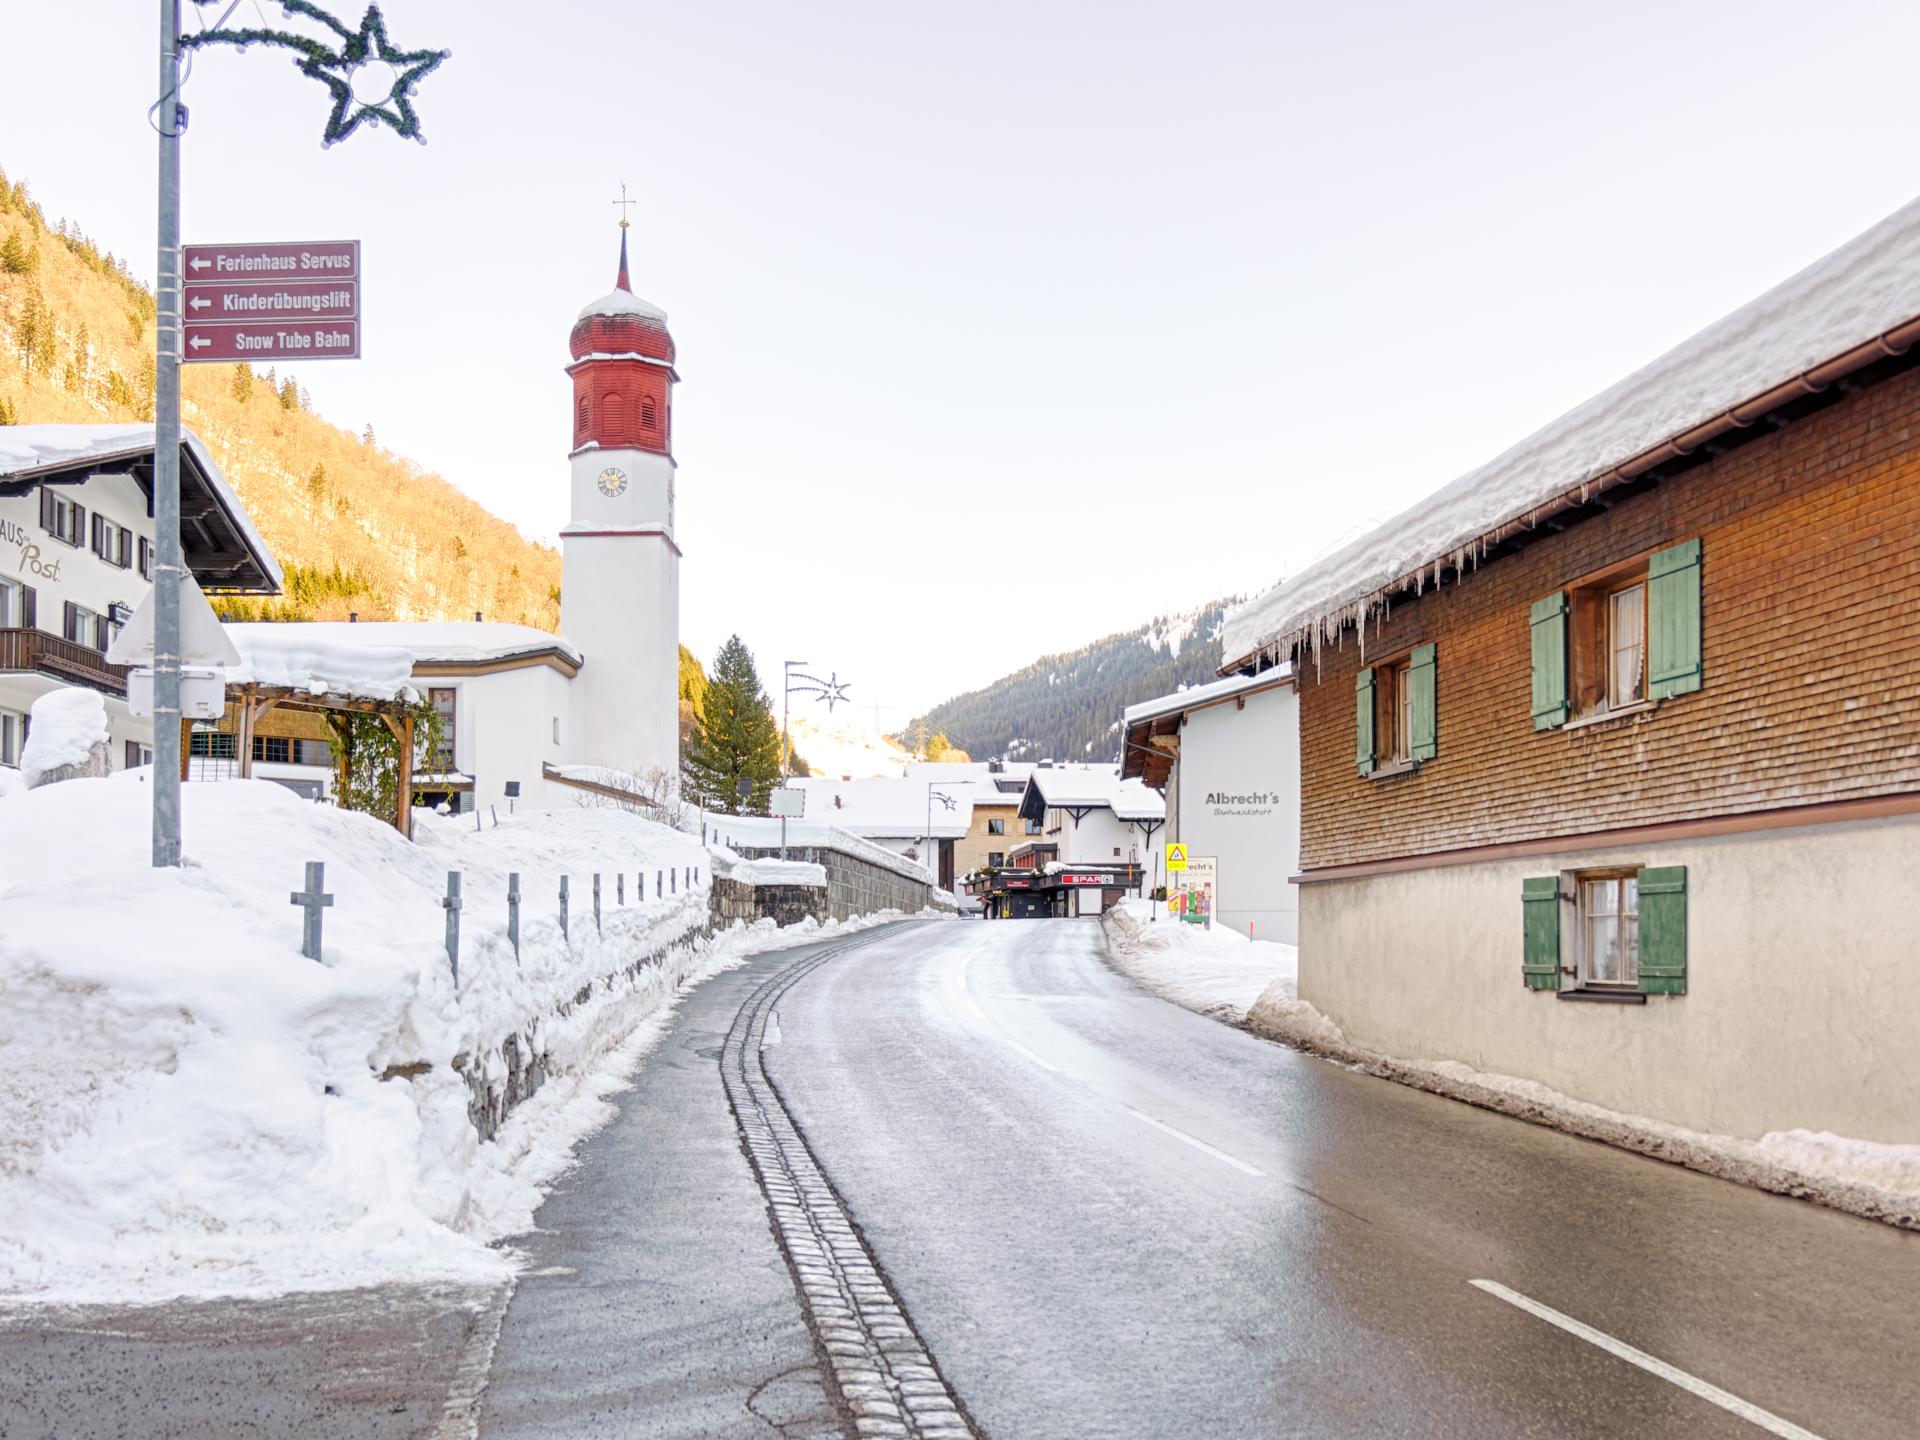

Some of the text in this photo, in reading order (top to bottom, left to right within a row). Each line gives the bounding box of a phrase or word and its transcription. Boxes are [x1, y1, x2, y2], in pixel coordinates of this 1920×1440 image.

[216, 251, 351, 272] Ferienhaus Servus
[223, 290, 351, 312] Kinderübungslift
[235, 330, 350, 350] Snow Tube Bahn
[19, 543, 61, 582] Post
[1205, 791, 1280, 805] Albrecht's
[1072, 875, 1102, 884] SPAR
